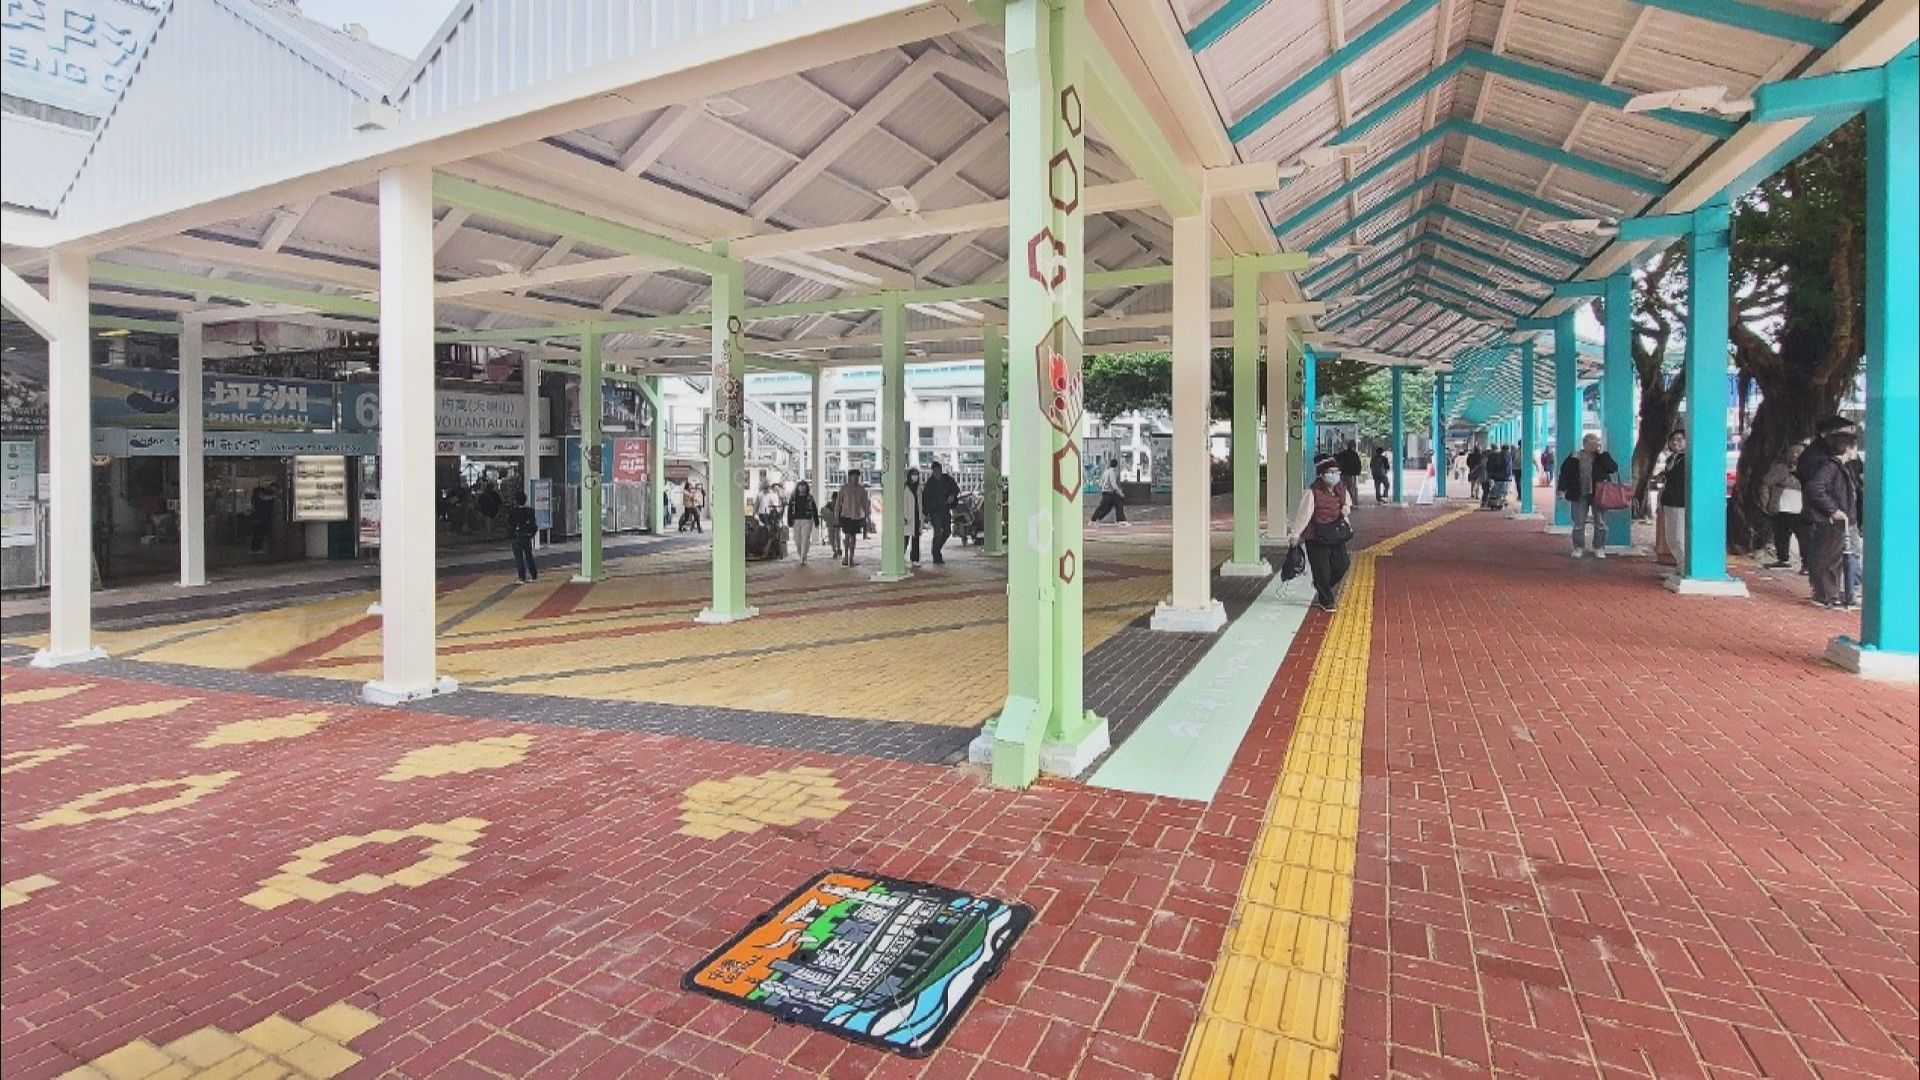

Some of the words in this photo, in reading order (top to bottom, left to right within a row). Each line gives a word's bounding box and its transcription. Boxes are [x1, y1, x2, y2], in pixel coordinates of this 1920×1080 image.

[208, 381, 308, 412] 坪洲
[355, 392, 379, 428] 6
[207, 412, 257, 424] PENG
[260, 414, 310, 427] CHAU
